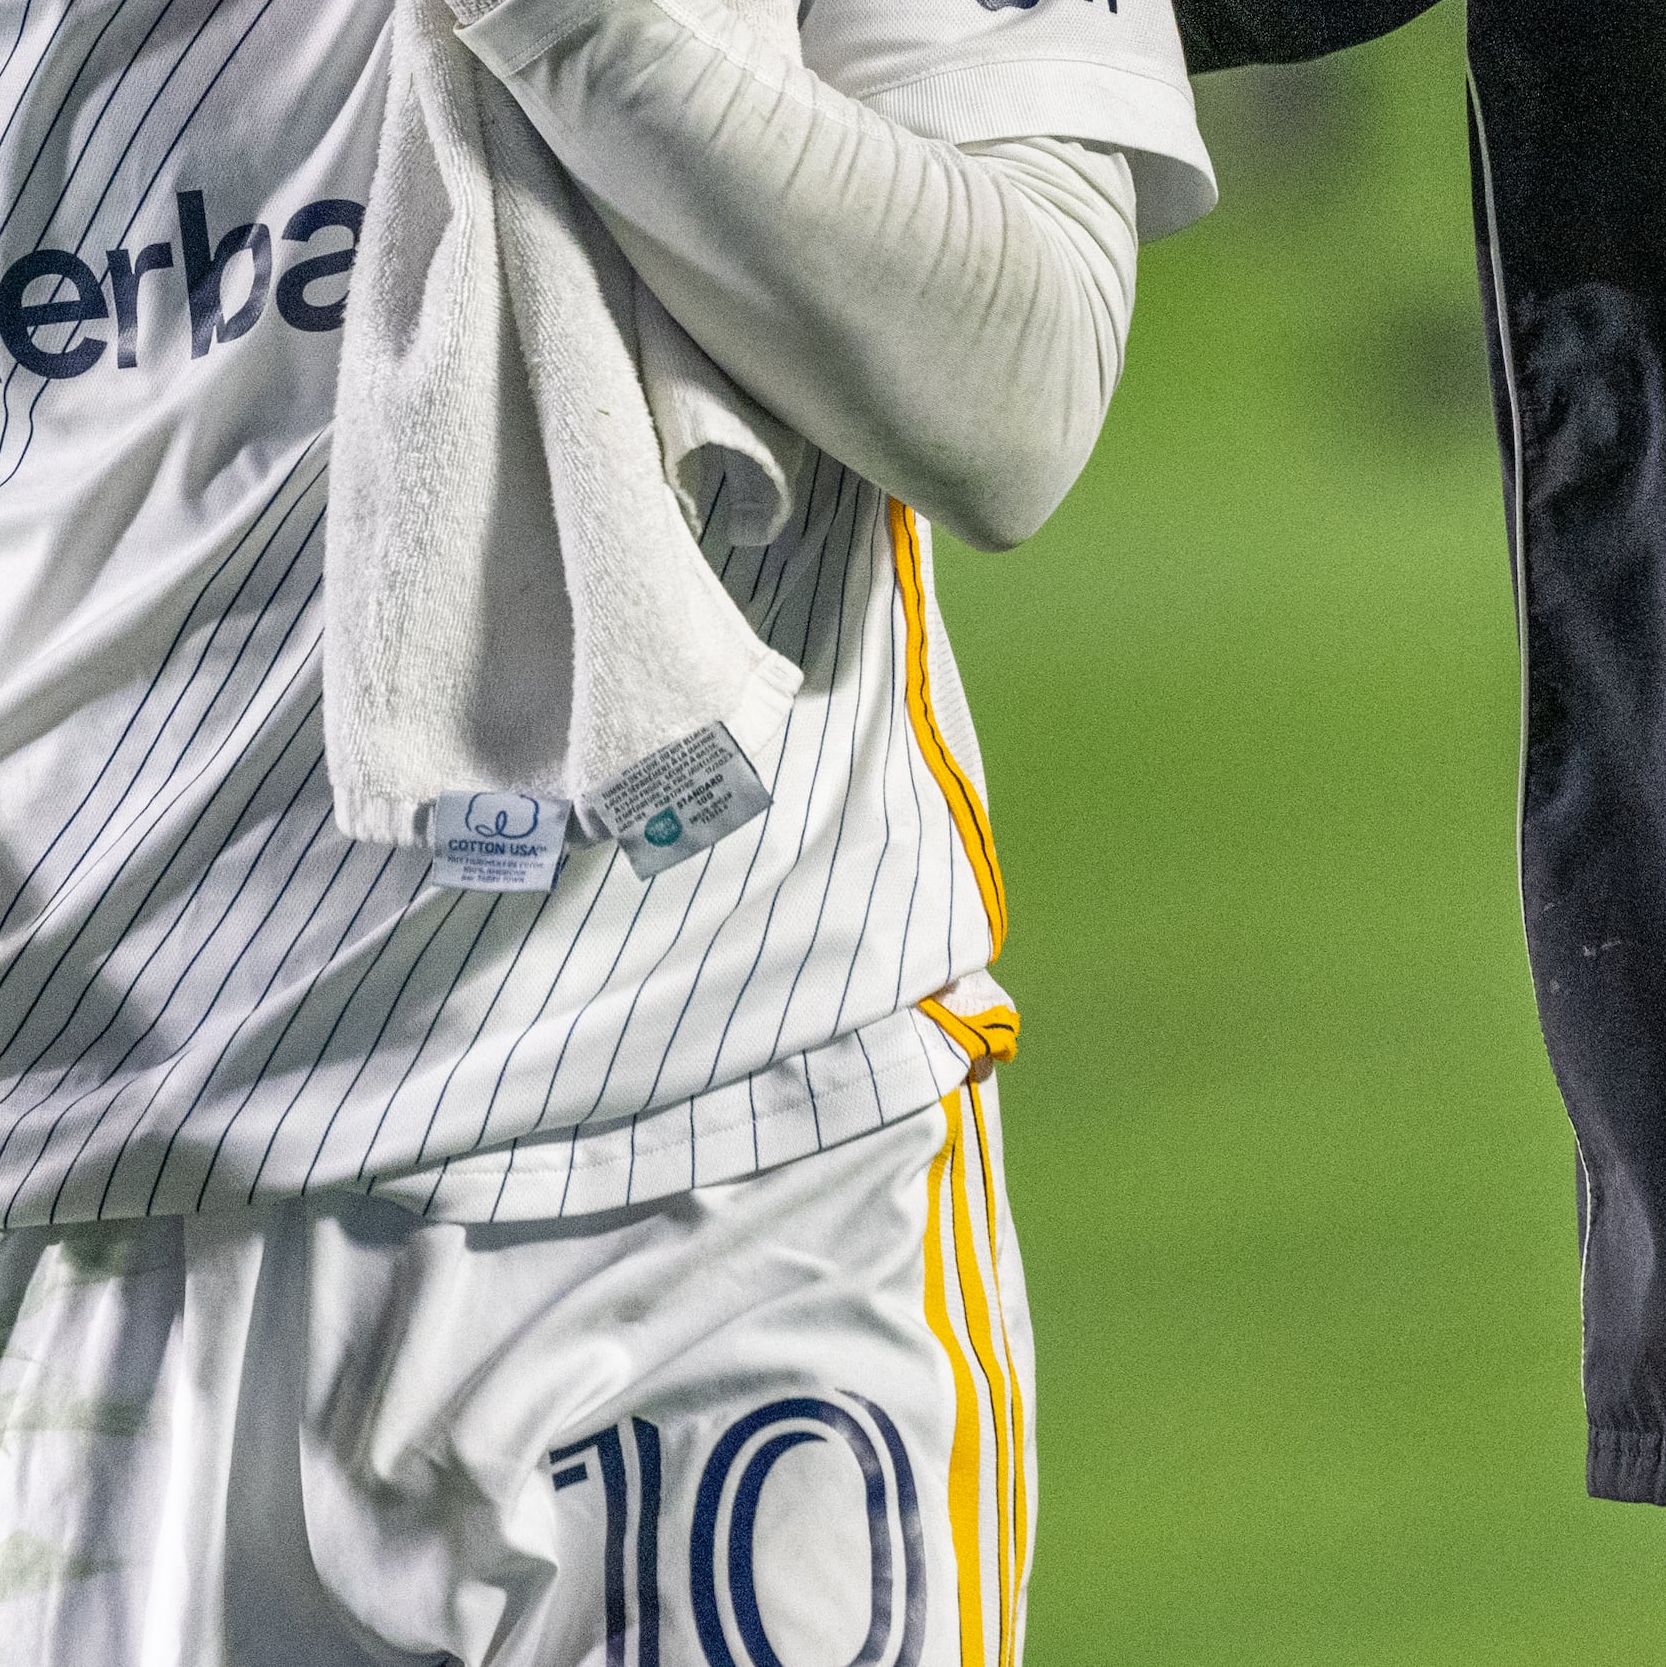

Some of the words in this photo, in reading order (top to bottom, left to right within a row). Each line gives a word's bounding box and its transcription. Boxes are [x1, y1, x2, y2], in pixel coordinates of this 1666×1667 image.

[676, 773, 724, 810] STANDARD
[448, 839, 505, 855] COTTON
[548, 1387, 927, 1667] 10
